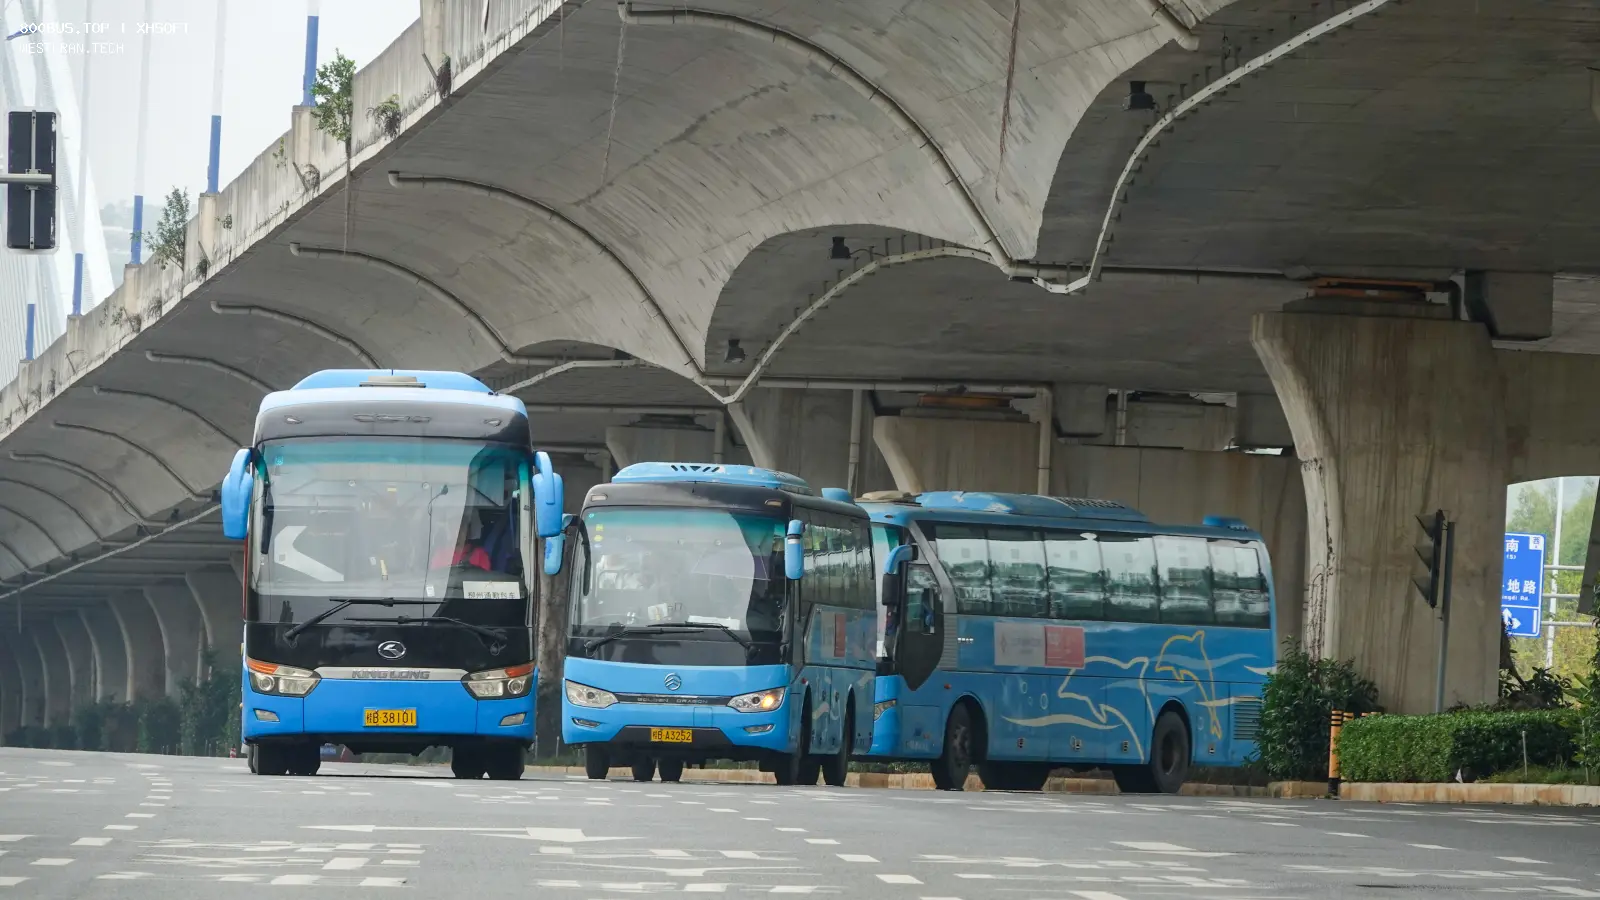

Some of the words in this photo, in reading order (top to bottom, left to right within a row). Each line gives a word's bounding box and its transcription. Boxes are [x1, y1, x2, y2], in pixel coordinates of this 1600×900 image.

[1505, 539, 1519, 552] 南
[1502, 578, 1537, 595] 地路
[352, 669, 388, 679] KING
[389, 670, 430, 680] LONG
